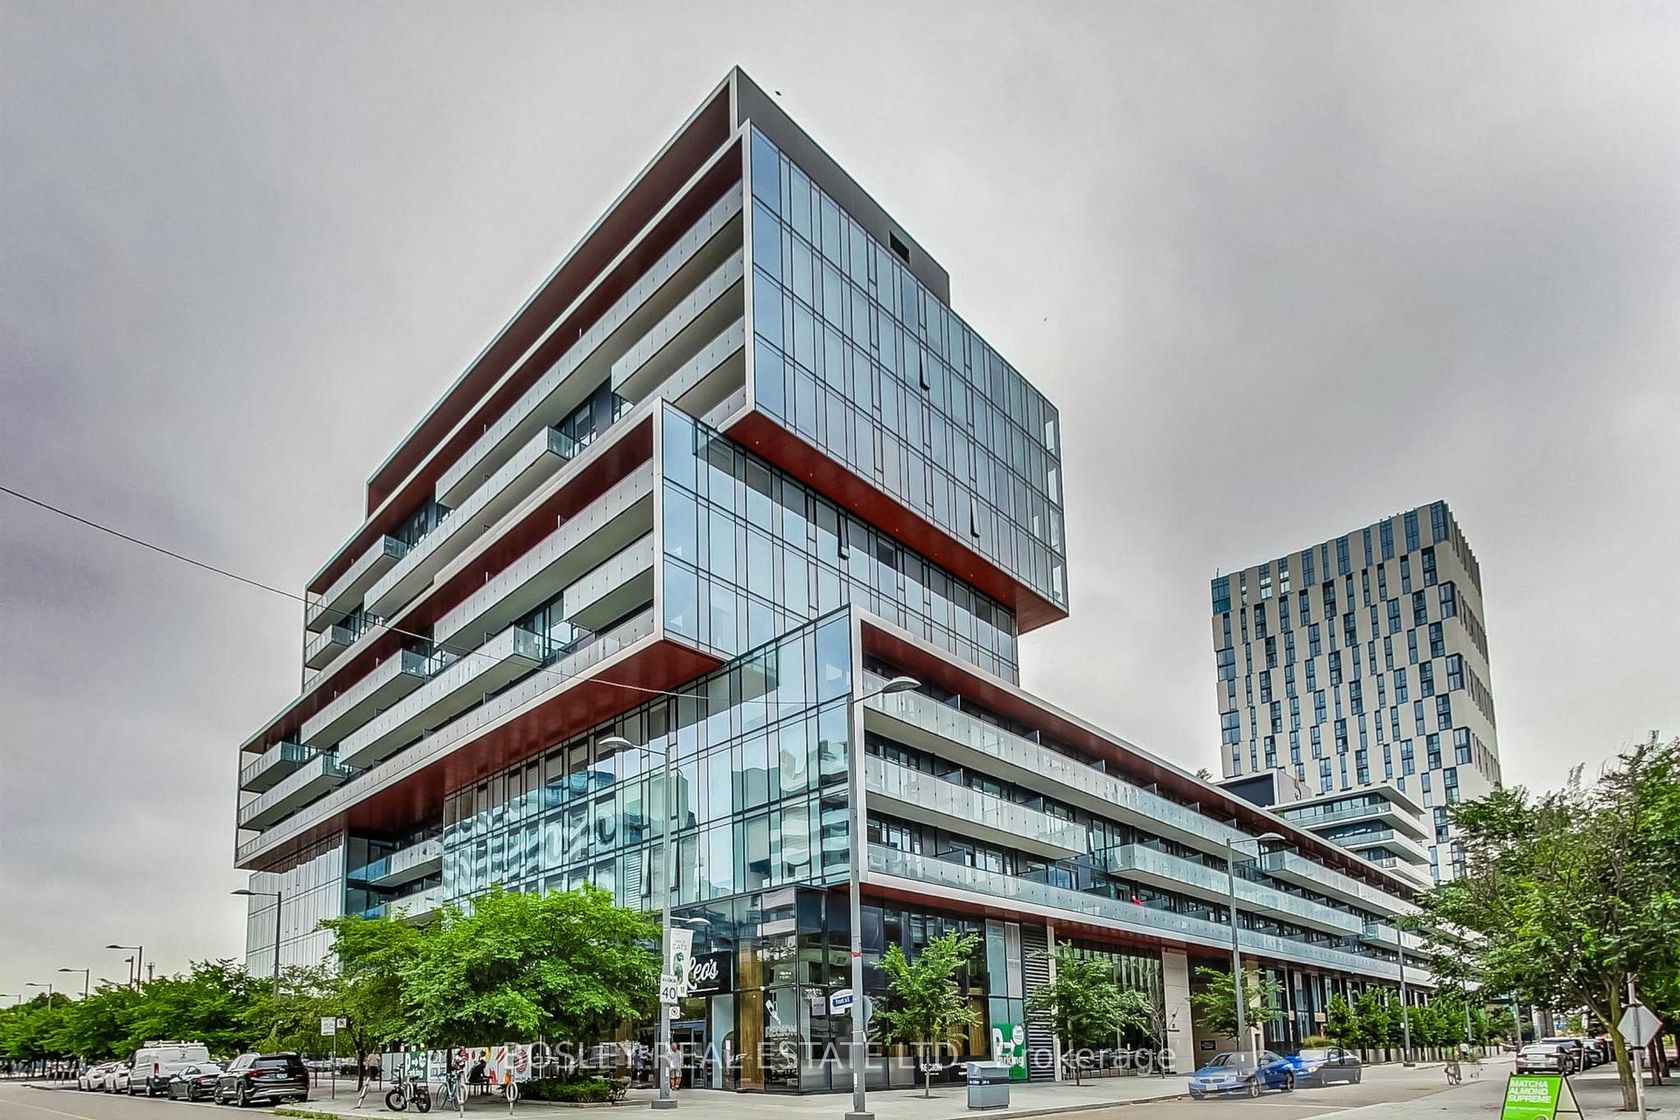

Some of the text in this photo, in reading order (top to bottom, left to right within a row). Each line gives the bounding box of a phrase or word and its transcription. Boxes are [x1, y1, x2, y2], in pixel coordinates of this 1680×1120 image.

[687, 956, 719, 990] Leo's
[662, 986, 677, 1000] 40
[765, 1024, 798, 1038] REGION
[920, 1063, 943, 1072] REGION
[1510, 1079, 1548, 1088] MATCHA
[1509, 1087, 1549, 1095] ALMOND
[1507, 1094, 1552, 1103] SUPREME
